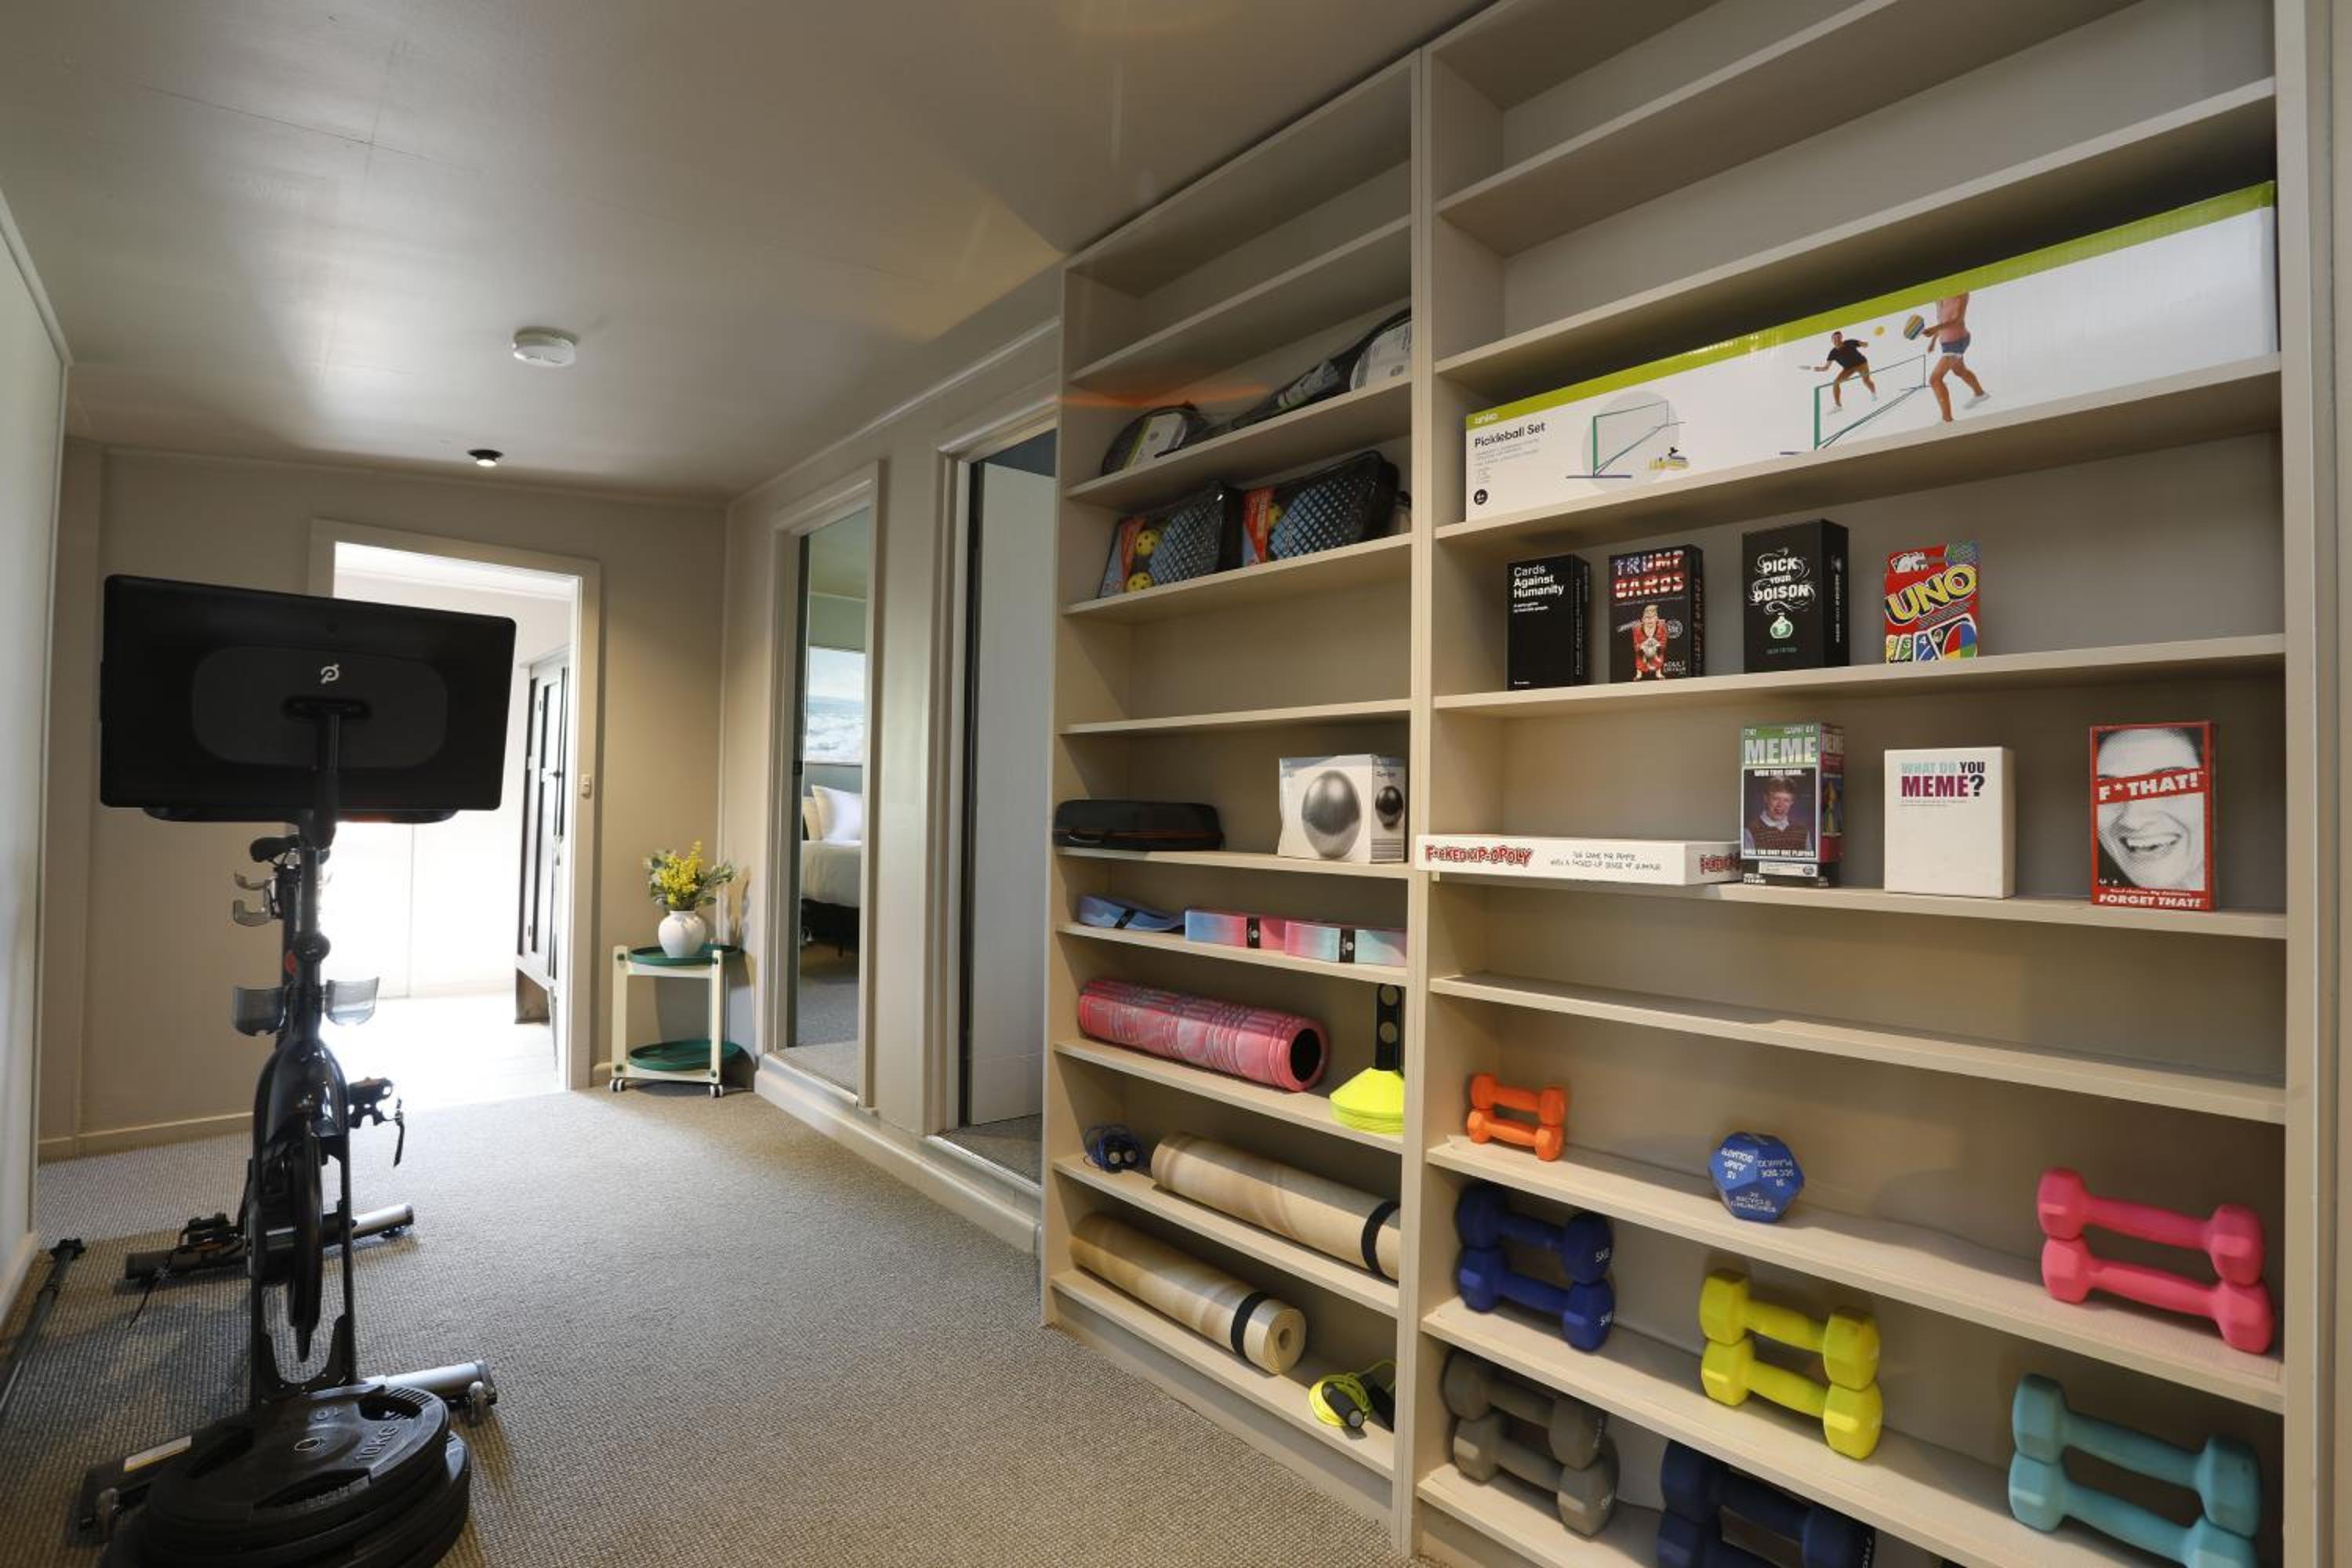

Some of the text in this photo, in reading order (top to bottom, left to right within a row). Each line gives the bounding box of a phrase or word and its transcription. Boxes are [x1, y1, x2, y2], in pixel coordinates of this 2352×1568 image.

[1475, 422, 1545, 448] Pickleball Set
[1514, 564, 1546, 577] Cards
[1615, 550, 1684, 576] TRUMP
[1763, 557, 1798, 574] PICK
[1513, 575, 1555, 589] Against
[1615, 573, 1685, 598] CARDS
[1769, 575, 1792, 584] YOUR
[1514, 585, 1565, 599] Humanity
[1753, 584, 1809, 603] POISON
[1885, 564, 1976, 626] UNO
[1744, 736, 1817, 764] MEME
[1901, 761, 1985, 774] WHAT DO YOU
[1901, 775, 1985, 797] MEME?
[2099, 894, 2201, 908] FORGET THAT!
[354, 1425, 399, 1463] 10KG
